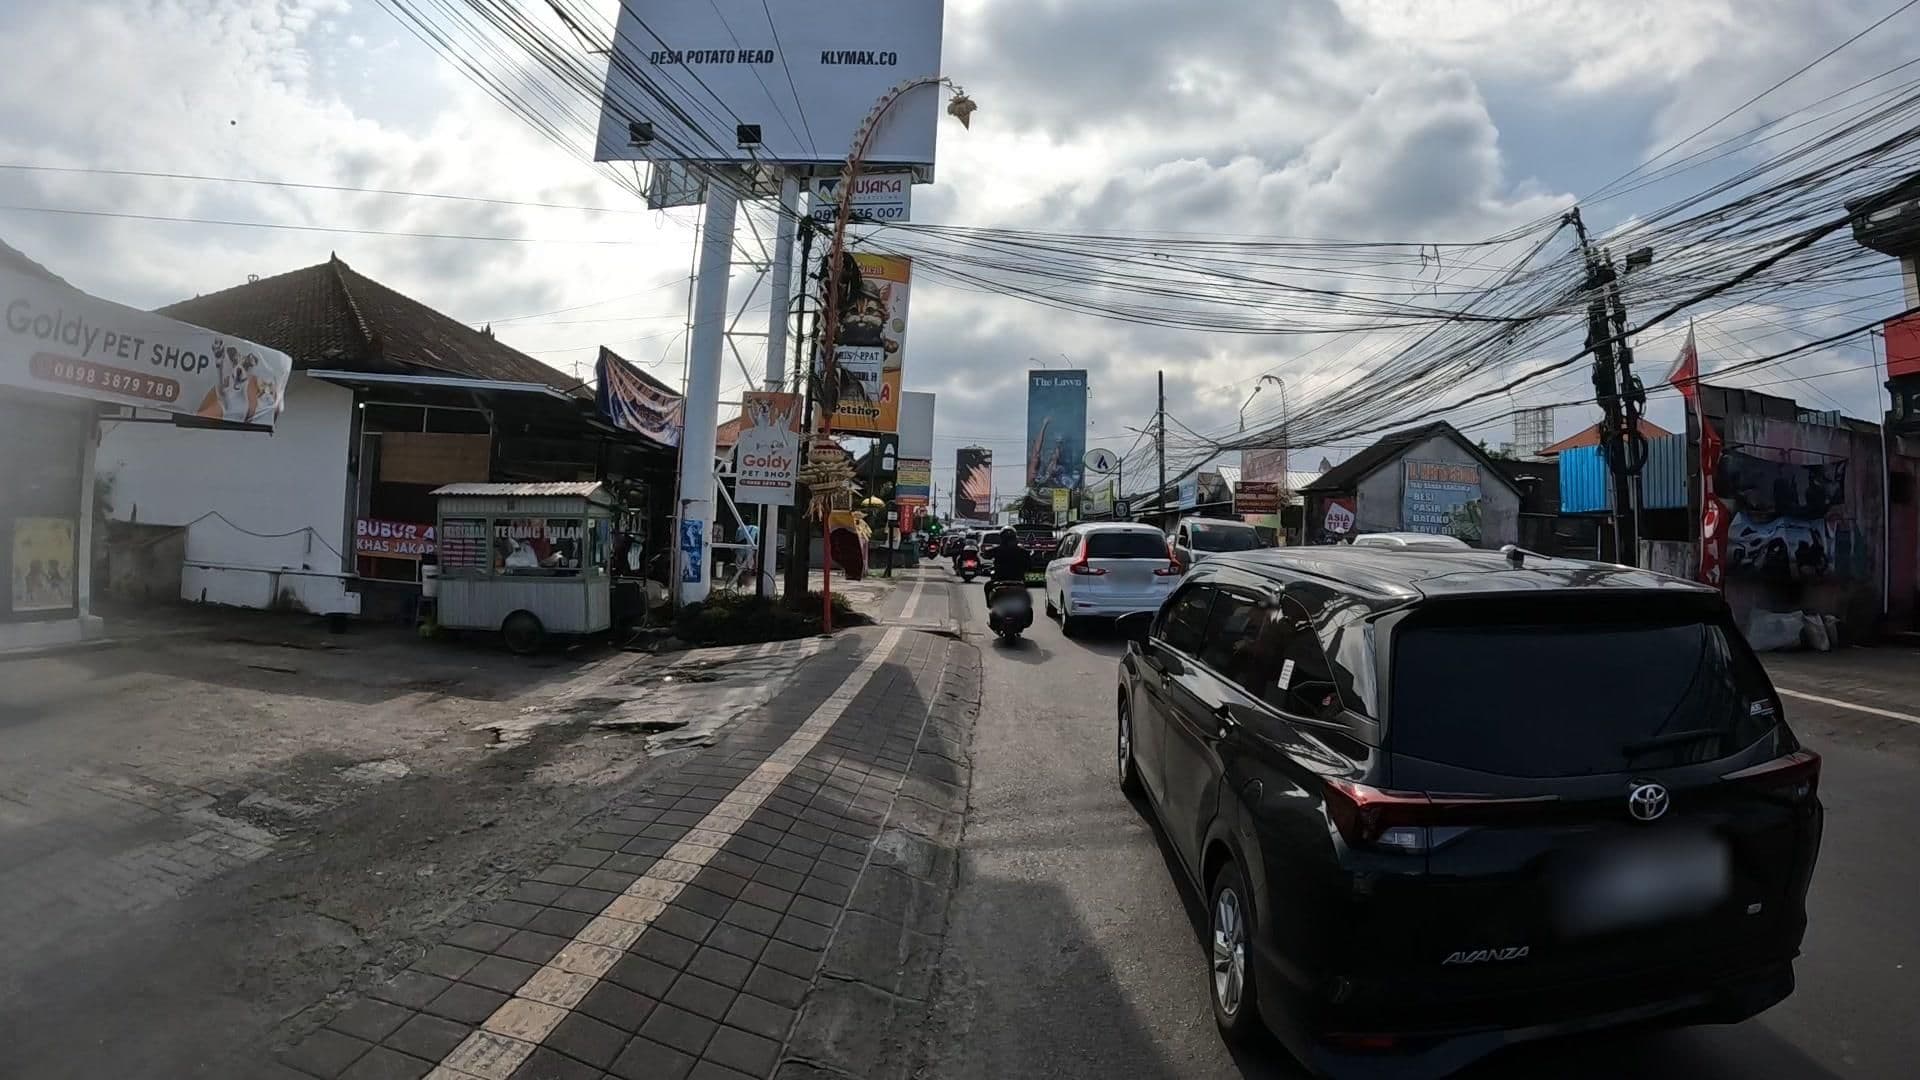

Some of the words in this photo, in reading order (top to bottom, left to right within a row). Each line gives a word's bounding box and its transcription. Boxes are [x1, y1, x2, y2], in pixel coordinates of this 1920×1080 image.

[650, 50, 682, 65] DESA
[685, 50, 735, 65] POTATO
[737, 50, 774, 64] HEAD
[820, 51, 897, 66] KLYMAX.CO
[877, 207, 904, 218] 007
[6, 299, 100, 358] Goldy
[102, 332, 144, 361] PET
[150, 343, 209, 374] SHOP
[53, 361, 96, 383] 0898
[101, 371, 140, 391] 3879
[146, 380, 174, 397] 788
[1033, 377, 1052, 387] The
[1054, 377, 1082, 386] Lawn
[832, 402, 880, 418] Petshop
[743, 454, 792, 470] Goldy
[1328, 513, 1350, 521] ASIA
[357, 519, 416, 539] BUBUR
[356, 538, 389, 552] KHAS
[1441, 945, 1530, 965] AVANZA
